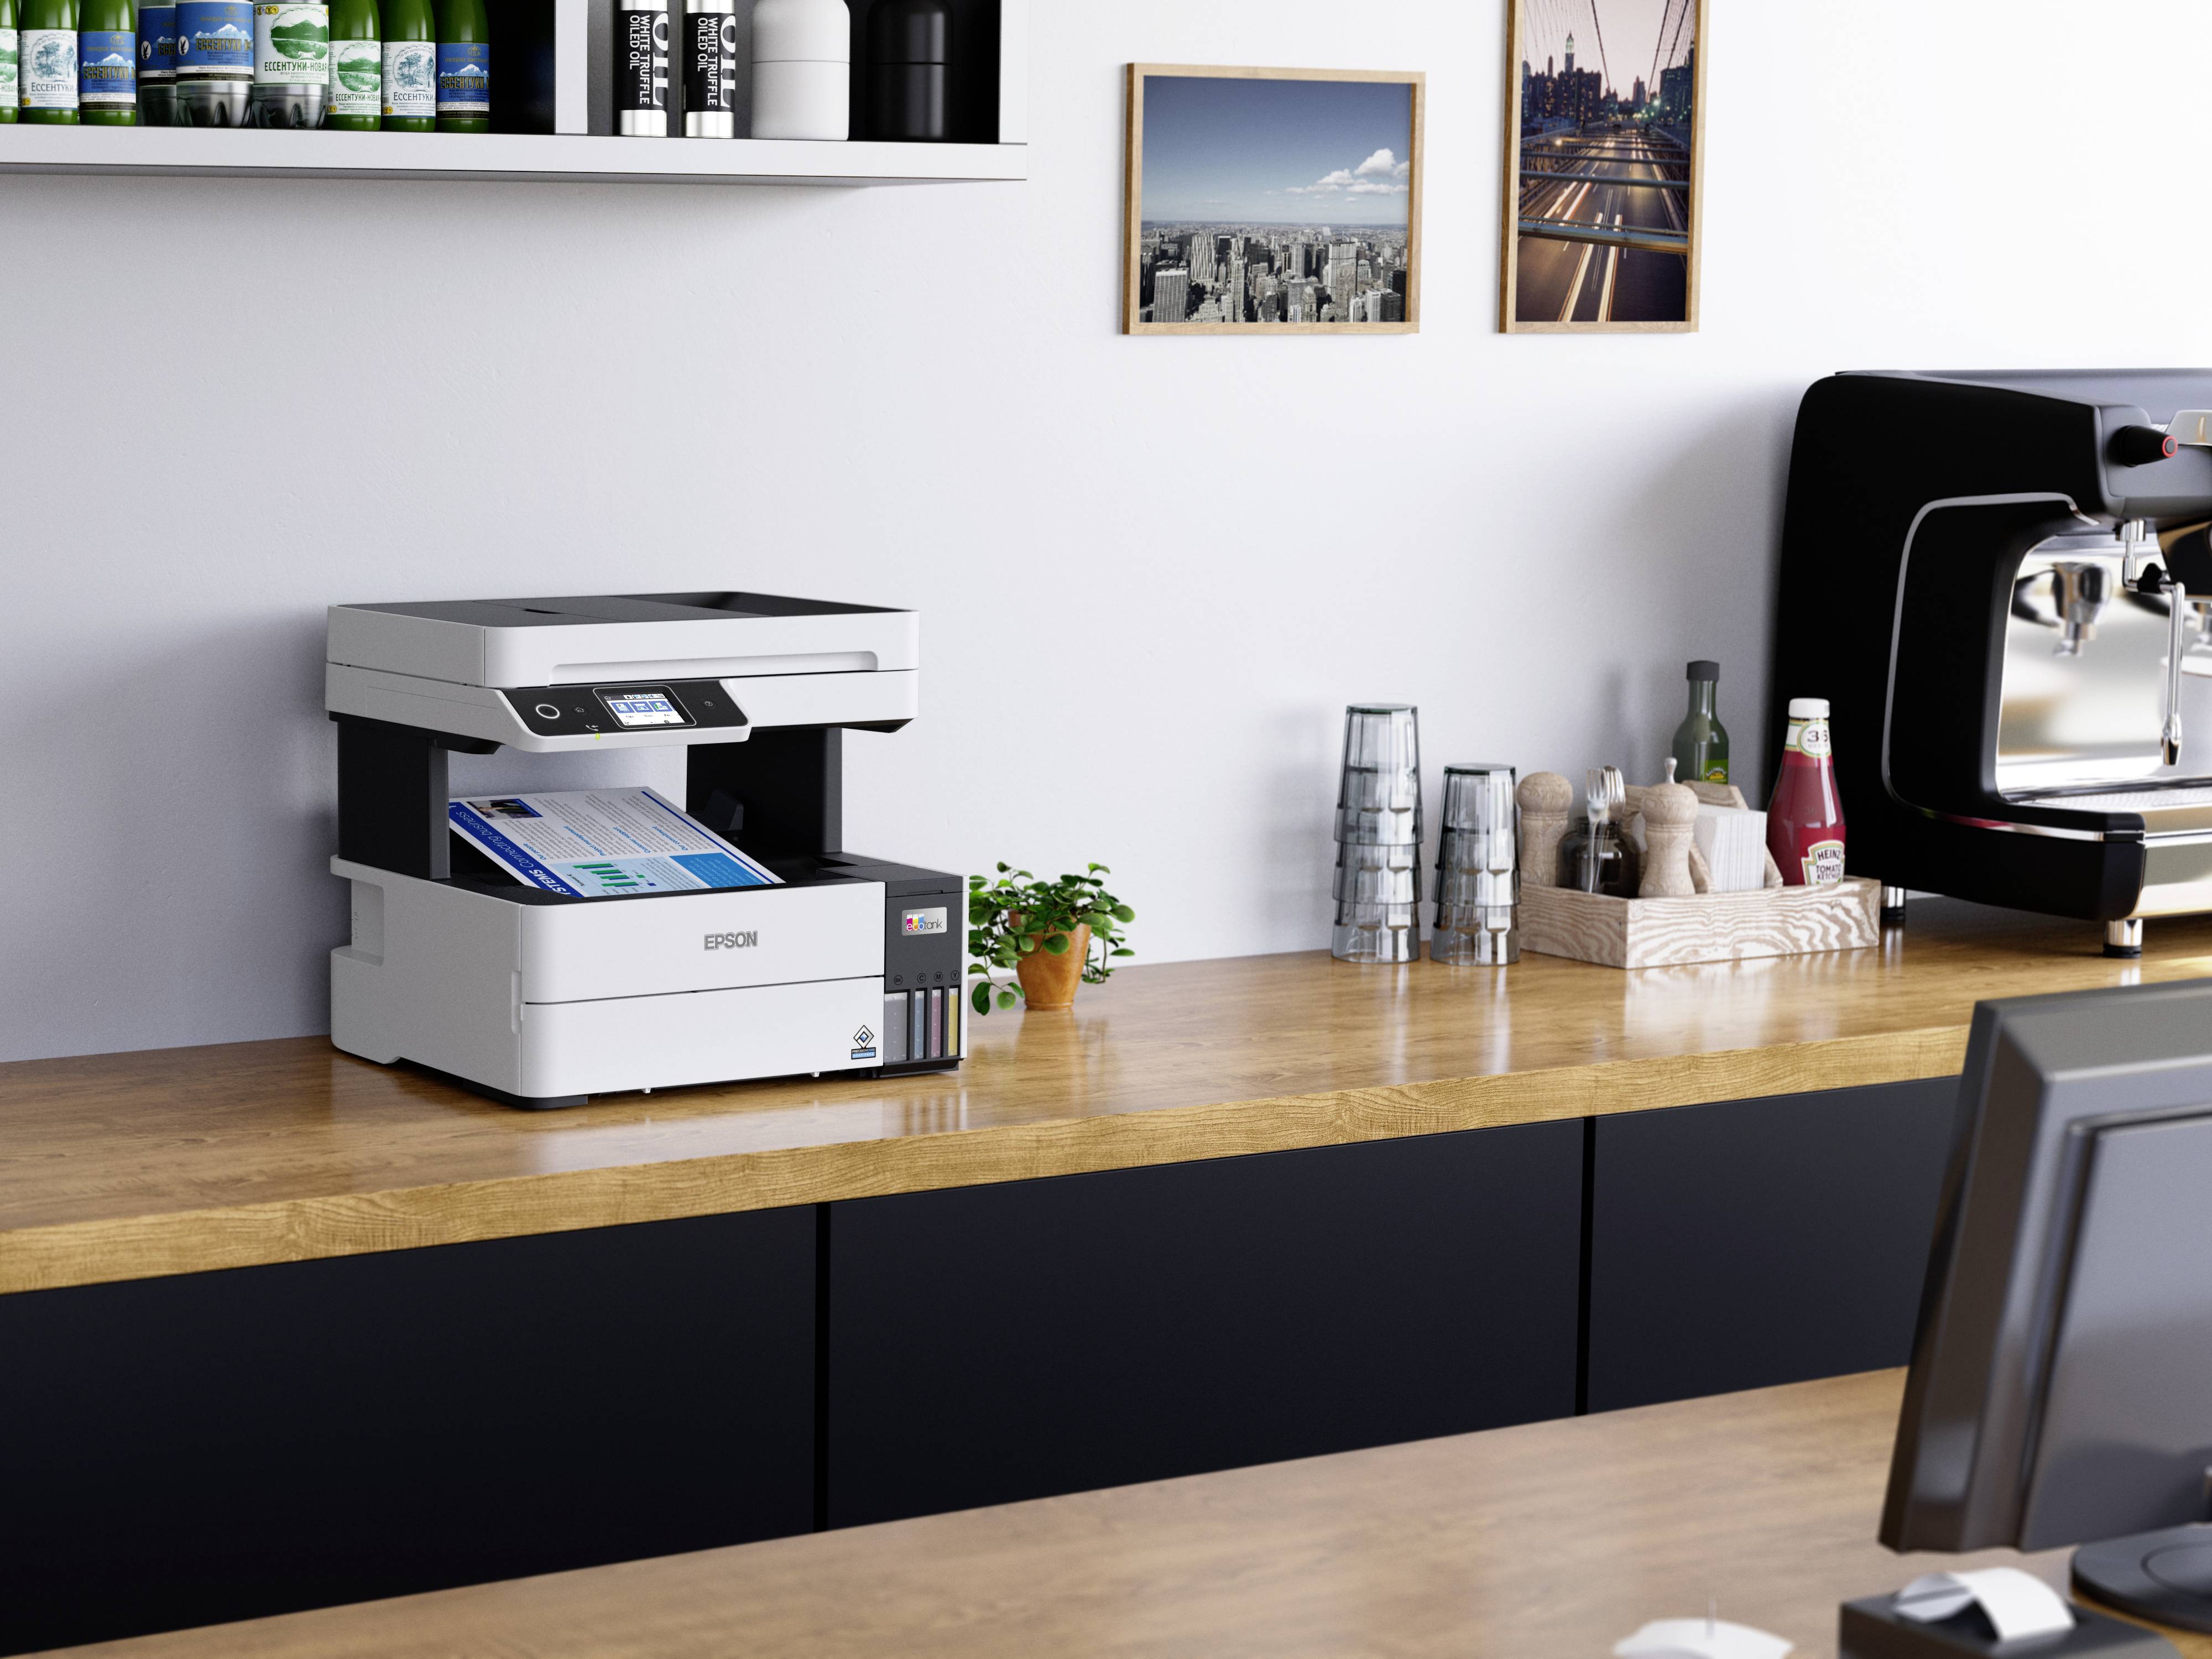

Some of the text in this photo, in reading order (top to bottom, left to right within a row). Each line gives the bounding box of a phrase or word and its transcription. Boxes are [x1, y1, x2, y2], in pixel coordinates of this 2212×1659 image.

[629, 15, 640, 70] OILED OIL
[639, 15, 650, 105] WHITE TRUFFLE
[653, 13, 668, 106] OIL
[697, 17, 708, 72] OILED OIL
[707, 17, 718, 106] WHITE TRUFFLE
[721, 15, 735, 108] OIL
[455, 811, 493, 836] business
[487, 836, 535, 868] Connecting
[1817, 849, 1841, 861] HEINZ
[704, 930, 758, 951] EPSON
